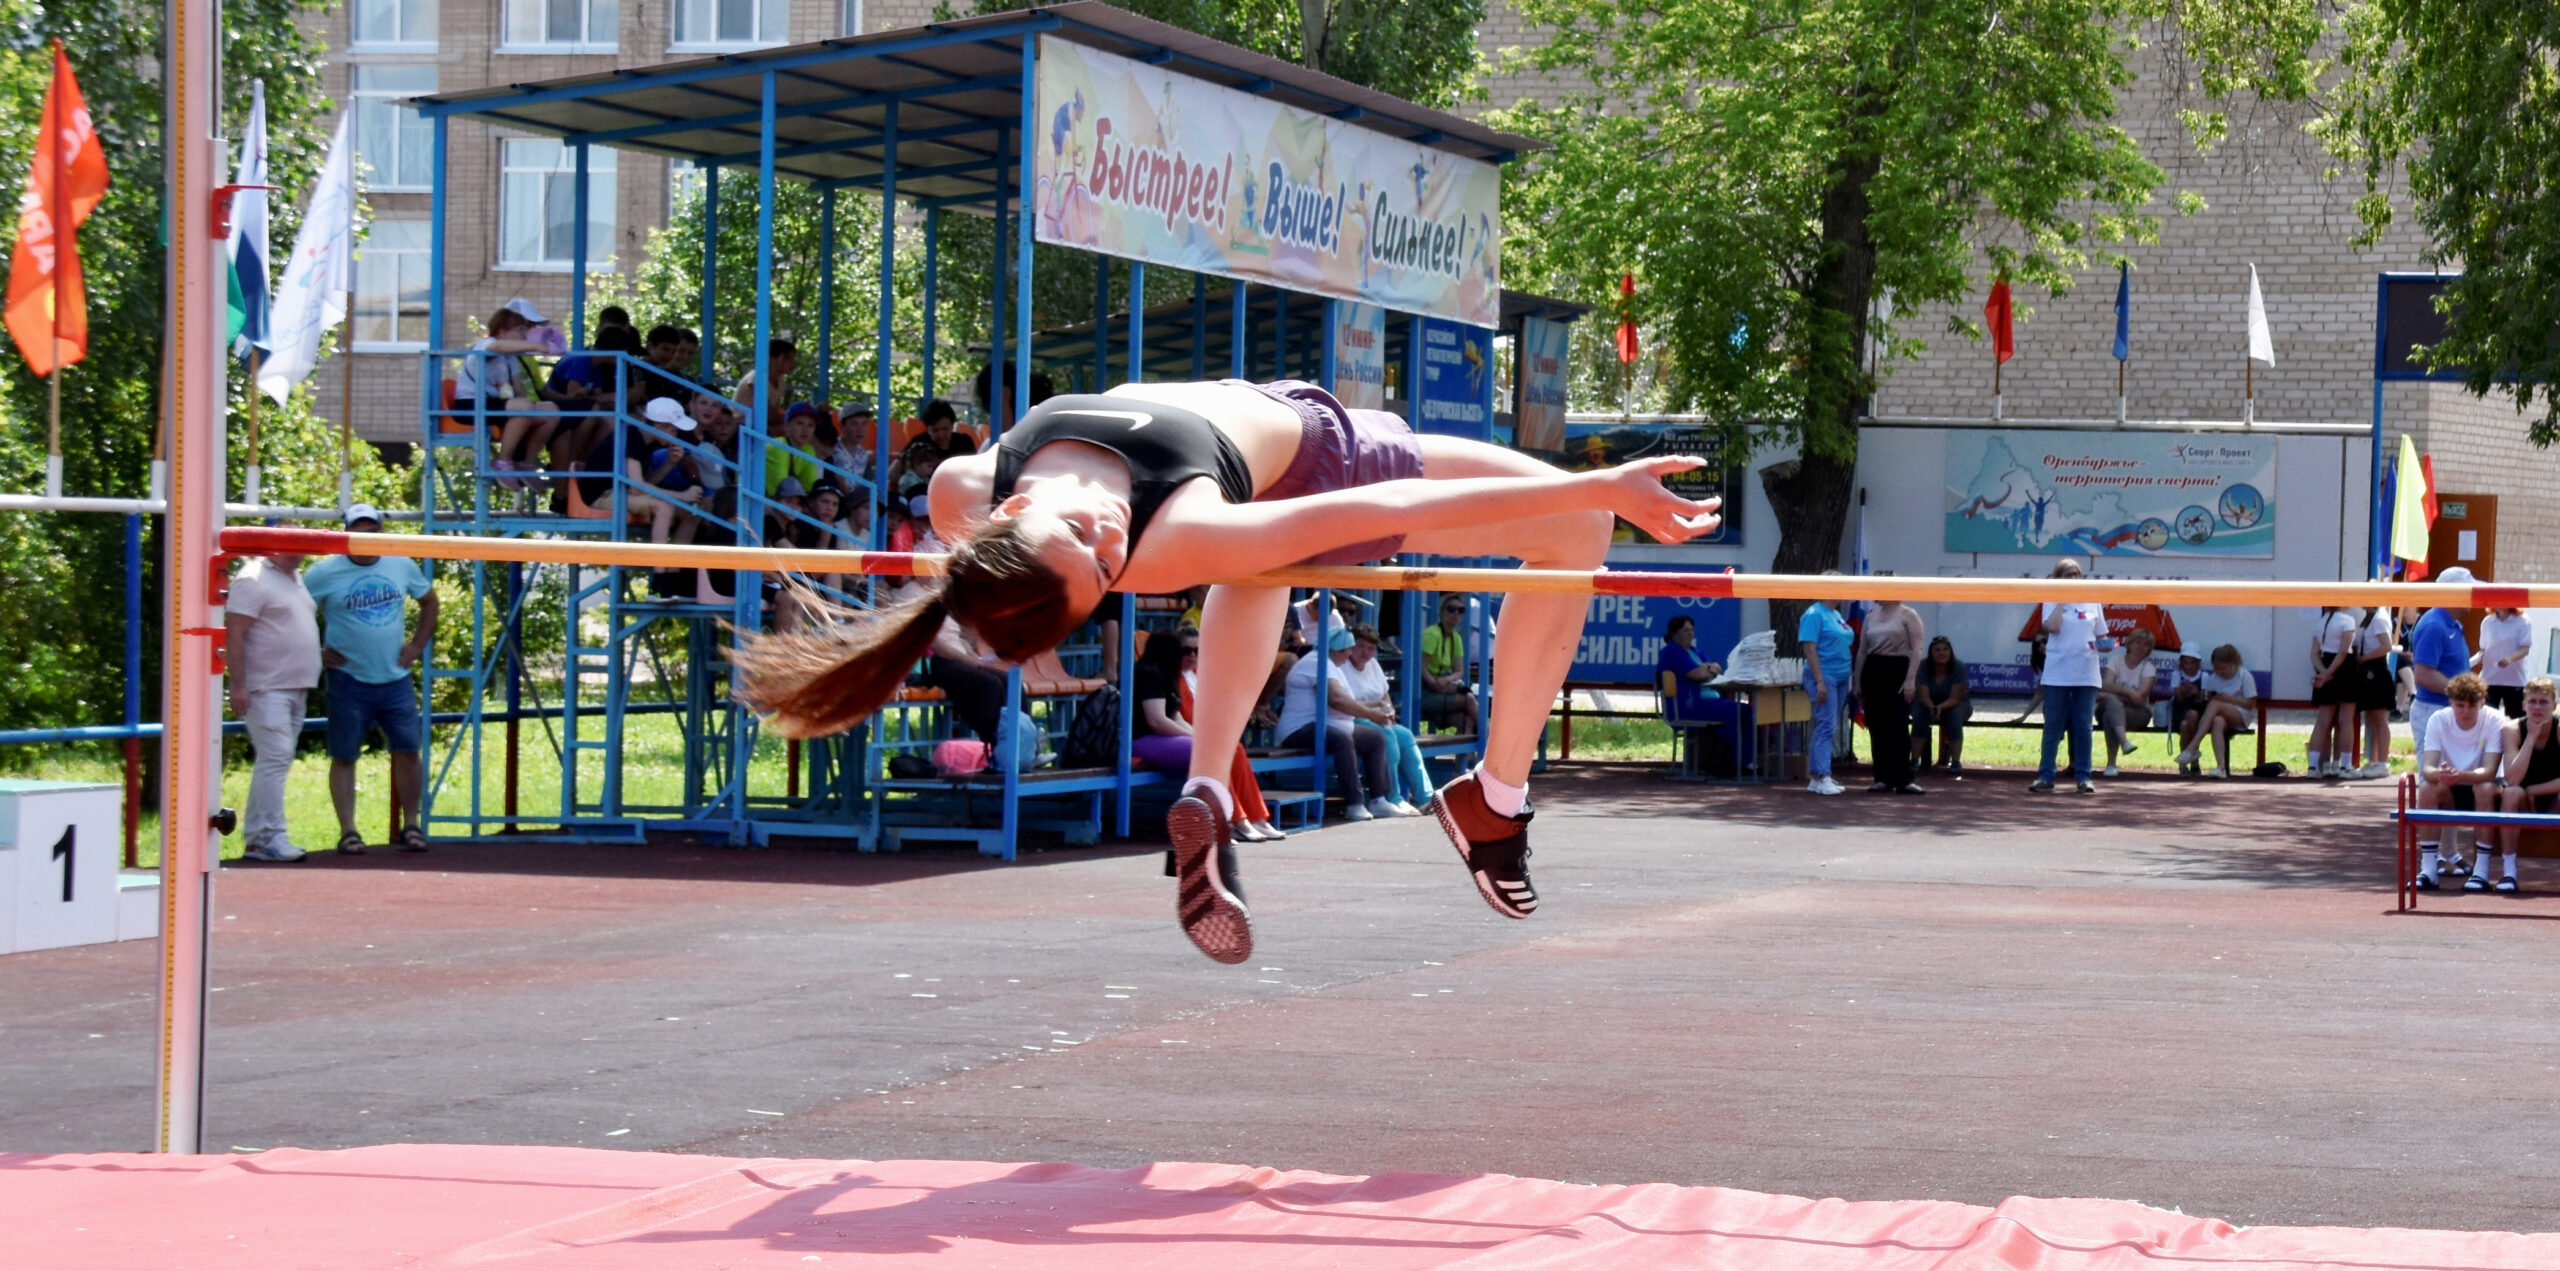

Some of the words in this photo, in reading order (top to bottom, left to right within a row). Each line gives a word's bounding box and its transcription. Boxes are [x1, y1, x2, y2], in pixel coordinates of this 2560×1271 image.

[1089, 116, 1232, 231] Быстрее!
[1262, 161, 1345, 256] Выше!
[1371, 191, 1467, 281] Сильнее!
[2188, 446, 2215, 459] Спорт
[2220, 446, 2252, 459] Проект
[2054, 474, 2153, 487] территория
[2156, 473, 2223, 487] спорта!
[1979, 664, 2020, 676] Оренбург
[1967, 679, 1981, 688] ул.
[1983, 677, 2031, 689] Советская,
[52, 823, 77, 903] 1
